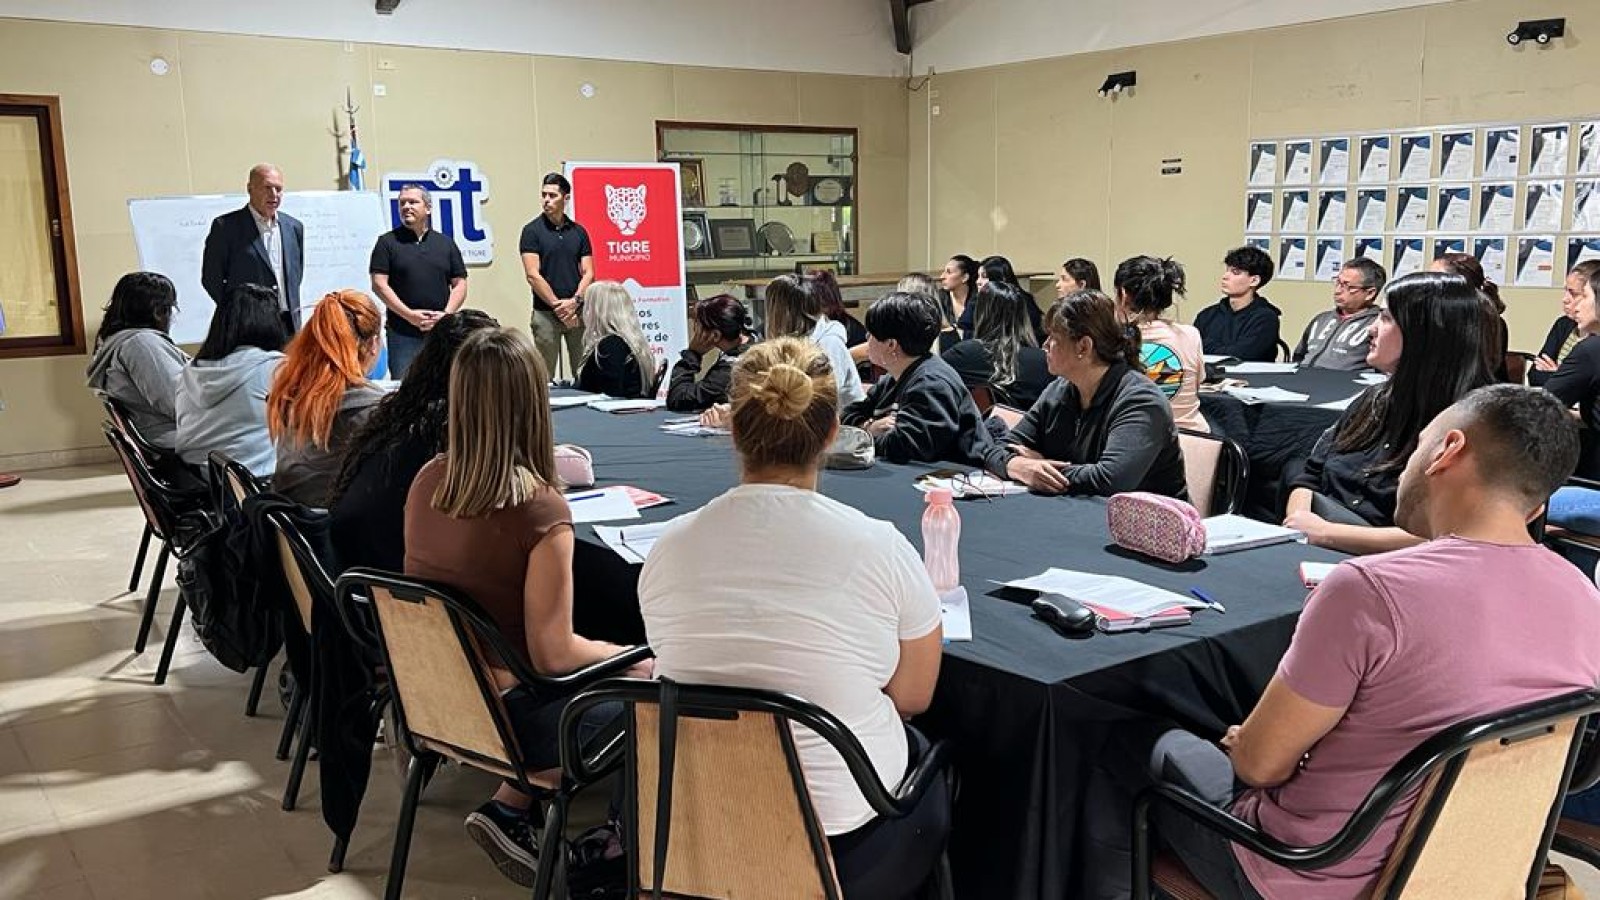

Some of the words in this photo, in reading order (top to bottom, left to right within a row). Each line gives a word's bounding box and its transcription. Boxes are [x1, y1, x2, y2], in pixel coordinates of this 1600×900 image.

[606, 240, 651, 254] TIGRE
[608, 254, 651, 262] MUNICIPIO
[654, 332, 669, 342] de
